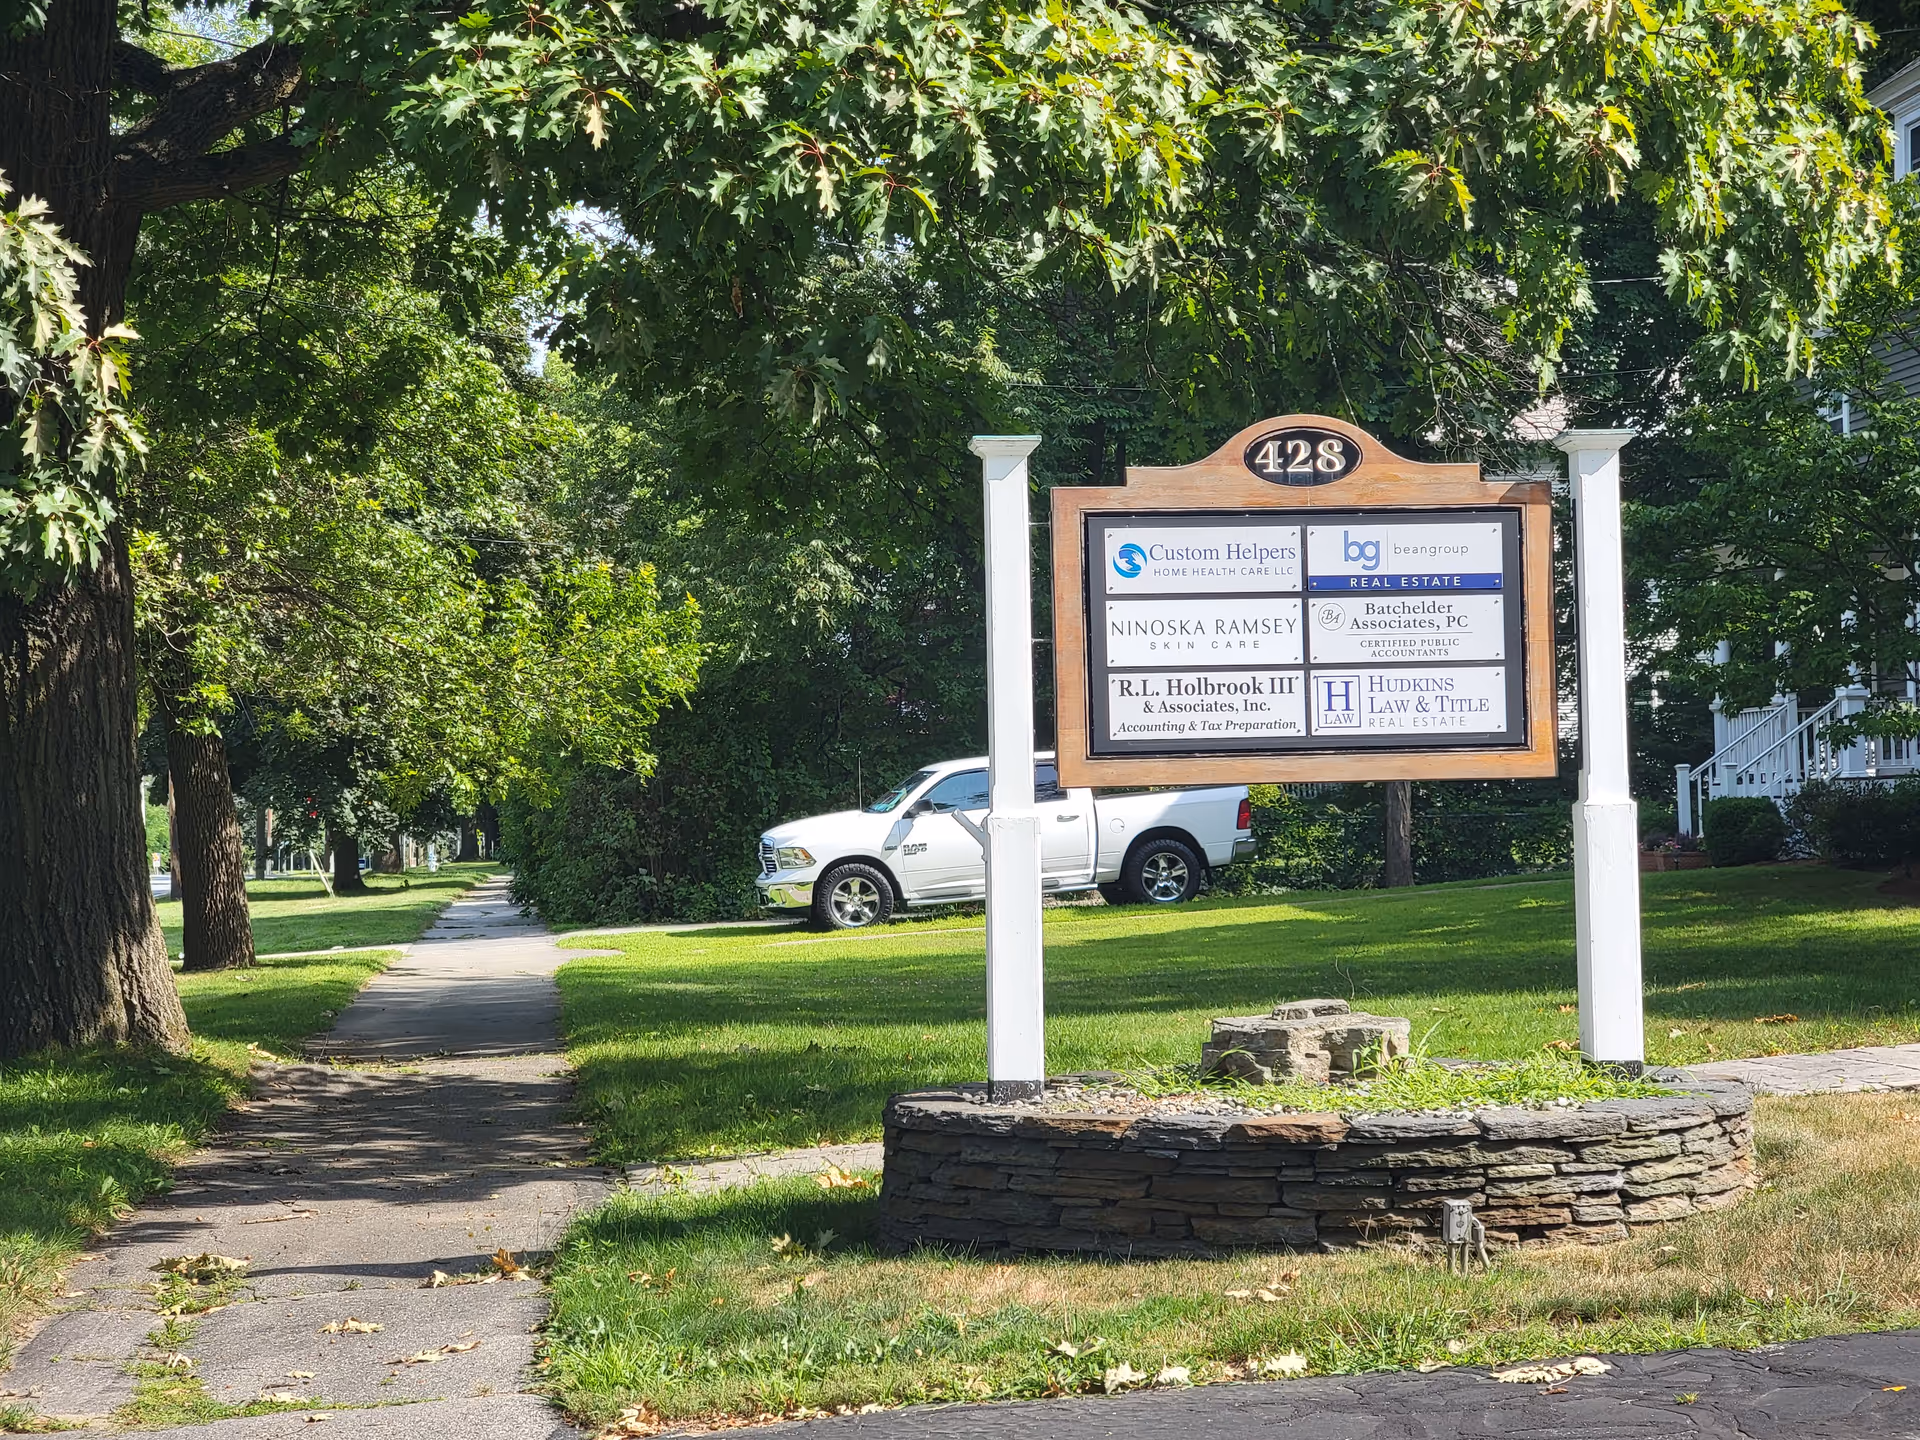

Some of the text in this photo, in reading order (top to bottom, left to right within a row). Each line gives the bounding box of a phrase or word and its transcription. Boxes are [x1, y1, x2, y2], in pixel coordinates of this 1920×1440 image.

[1255, 439, 1346, 472] 428
[1149, 543, 1296, 564] Custom Helpers
[1344, 530, 1380, 571] bg
[1394, 543, 1469, 557] beangroup
[1154, 566, 1294, 577] HOME HEALTH CARE LLC
[1350, 576, 1461, 588] REAL ESTATE
[1364, 601, 1453, 615] Batchelder
[1111, 618, 1297, 636] NINOSKA RAMSEY
[1349, 615, 1468, 631] Associates, PC
[1150, 640, 1260, 650] SKIN CARE
[1360, 638, 1460, 648] CERTIFIED PUBLIC
[1371, 648, 1449, 658] ACCOUNTANTS
[1118, 676, 1295, 697] R.L. Holbrook III
[1368, 675, 1455, 693] HUDKINS
[1323, 681, 1354, 712] H
[1143, 699, 1271, 714] & Associates, Inc.
[1368, 695, 1490, 714] LAW & TITLE
[1117, 718, 1297, 734] Accounting & Tax Preparation
[1324, 713, 1354, 725] LAW
[1369, 716, 1466, 728] REAL ESTATE
